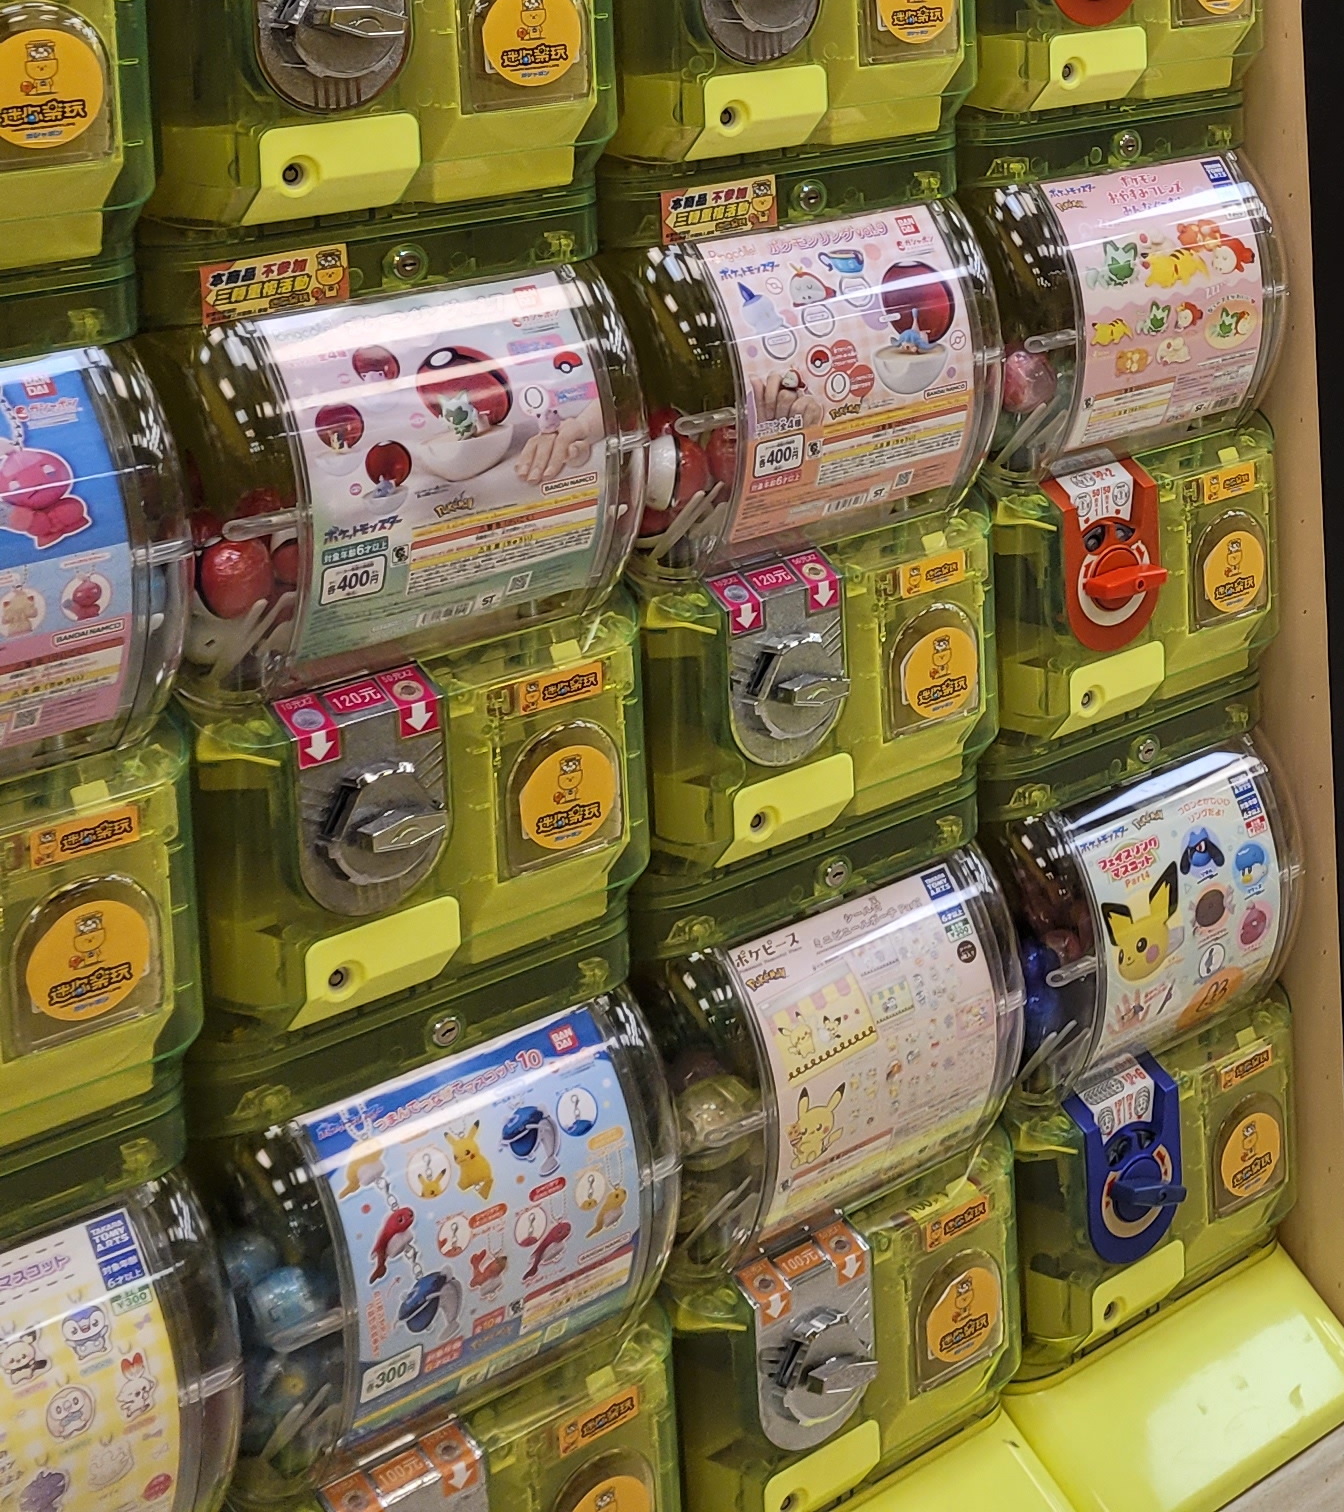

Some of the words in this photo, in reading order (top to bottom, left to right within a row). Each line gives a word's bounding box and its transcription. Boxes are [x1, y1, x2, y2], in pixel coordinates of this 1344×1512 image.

[1119, 174, 1158, 187] ポケモン
[1107, 181, 1183, 205] おやすみフレンズ
[769, 228, 855, 256] ポケモンリング
[209, 266, 257, 288] 本商品
[719, 260, 780, 281] ポケットモンスター
[26, 383, 50, 396] DAI
[544, 480, 569, 492] BANDAI
[569, 475, 595, 487] NAMCO
[324, 516, 402, 544] ポケットモンスター
[752, 569, 792, 588] 120元
[481, 594, 496, 607] ST
[56, 630, 89, 644] BANDAI
[88, 621, 122, 635] NAMCO
[332, 687, 383, 709] 120元
[1098, 835, 1160, 870] フェイスリング
[1110, 855, 1154, 879] マスコット
[927, 878, 948, 891] TOMY
[929, 884, 952, 897] ARTS
[735, 932, 800, 968] ポケピース
[551, 1027, 573, 1042] BAN
[554, 1038, 574, 1051] DAI
[515, 1048, 543, 1070] 10
[90, 1219, 122, 1237] TAKARA
[92, 1228, 126, 1244] TOMY
[96, 1234, 130, 1252] ARTS
[782, 1250, 818, 1274] 100元
[117, 1292, 148, 1309] ¥300
